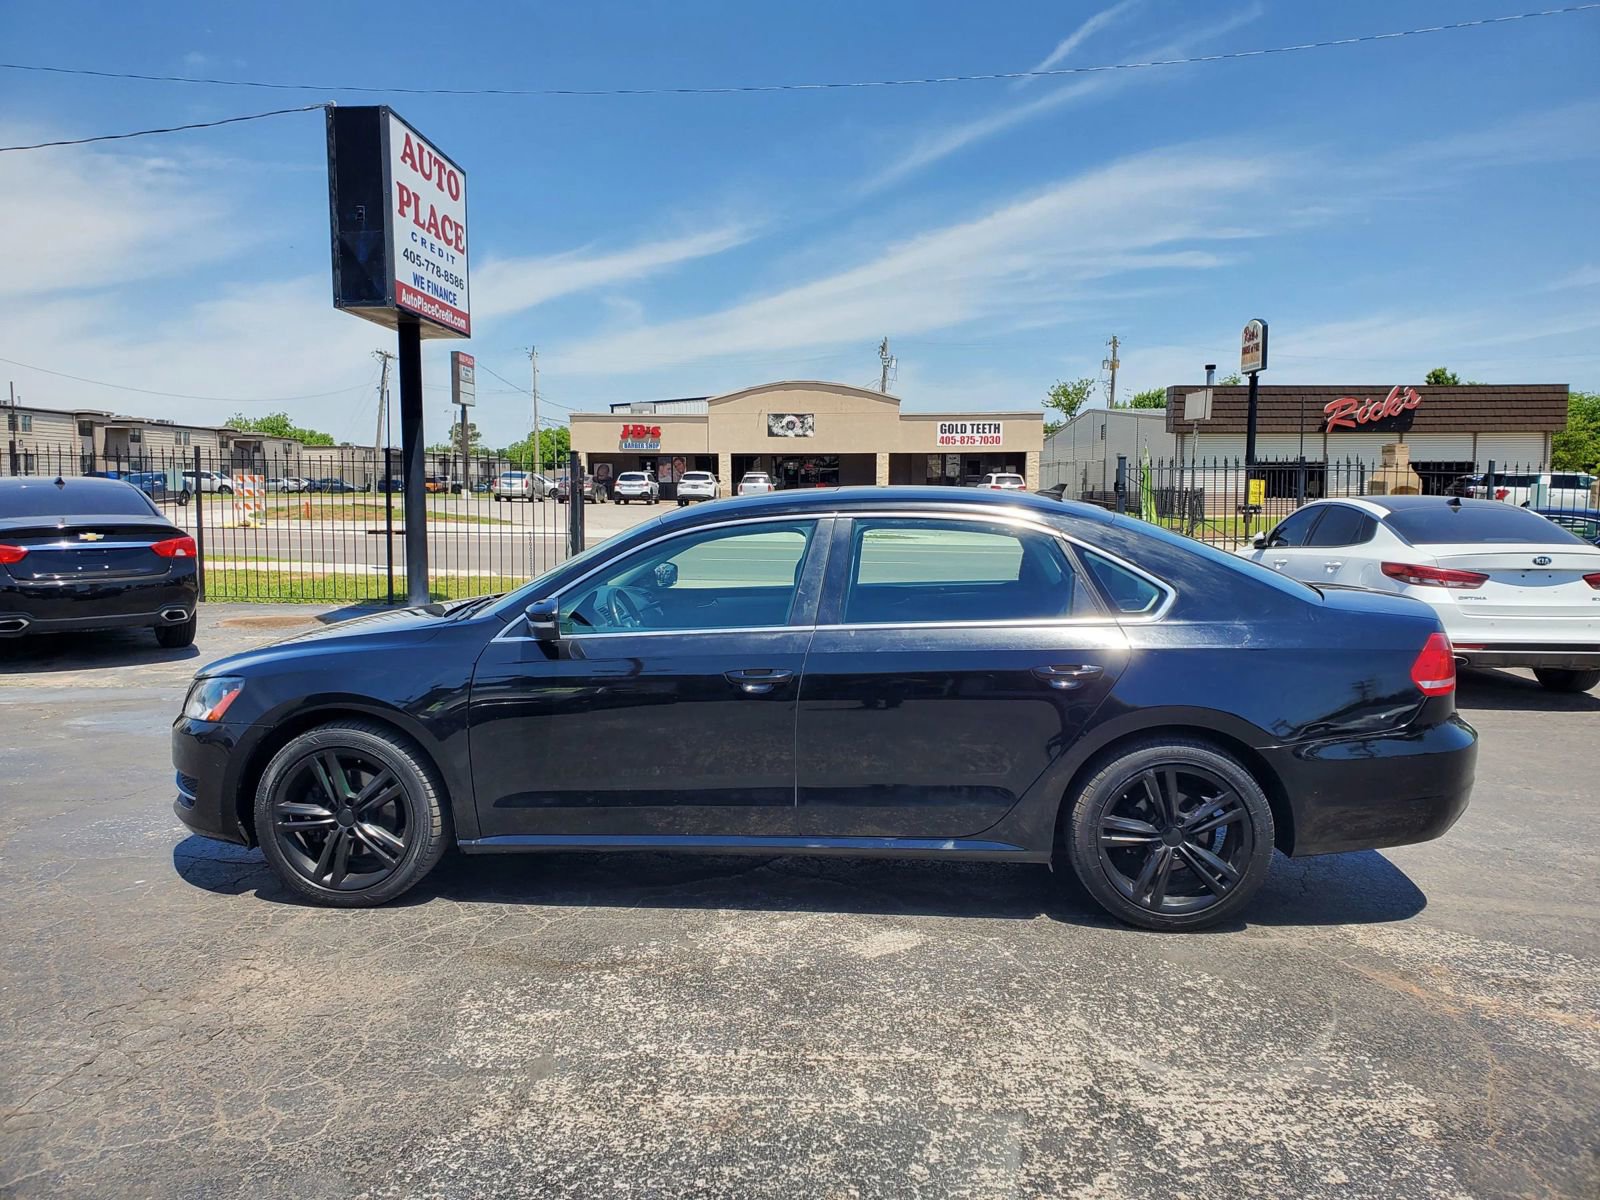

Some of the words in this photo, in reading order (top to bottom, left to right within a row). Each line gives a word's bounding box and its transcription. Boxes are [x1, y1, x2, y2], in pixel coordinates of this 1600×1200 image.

[400, 132, 460, 201] AUTO
[396, 181, 465, 255] PLACE
[402, 247, 464, 290] 405-778-8586
[411, 231, 455, 265] CREDIT
[401, 288, 466, 329] AutoPlaceCredit.com
[412, 271, 425, 290] WE
[427, 279, 457, 306] FINANCE
[940, 423, 967, 434] GOLD
[970, 423, 1001, 434] TEETH
[1323, 384, 1422, 433] Rick's
[939, 435, 1001, 445] 405-875-7030
